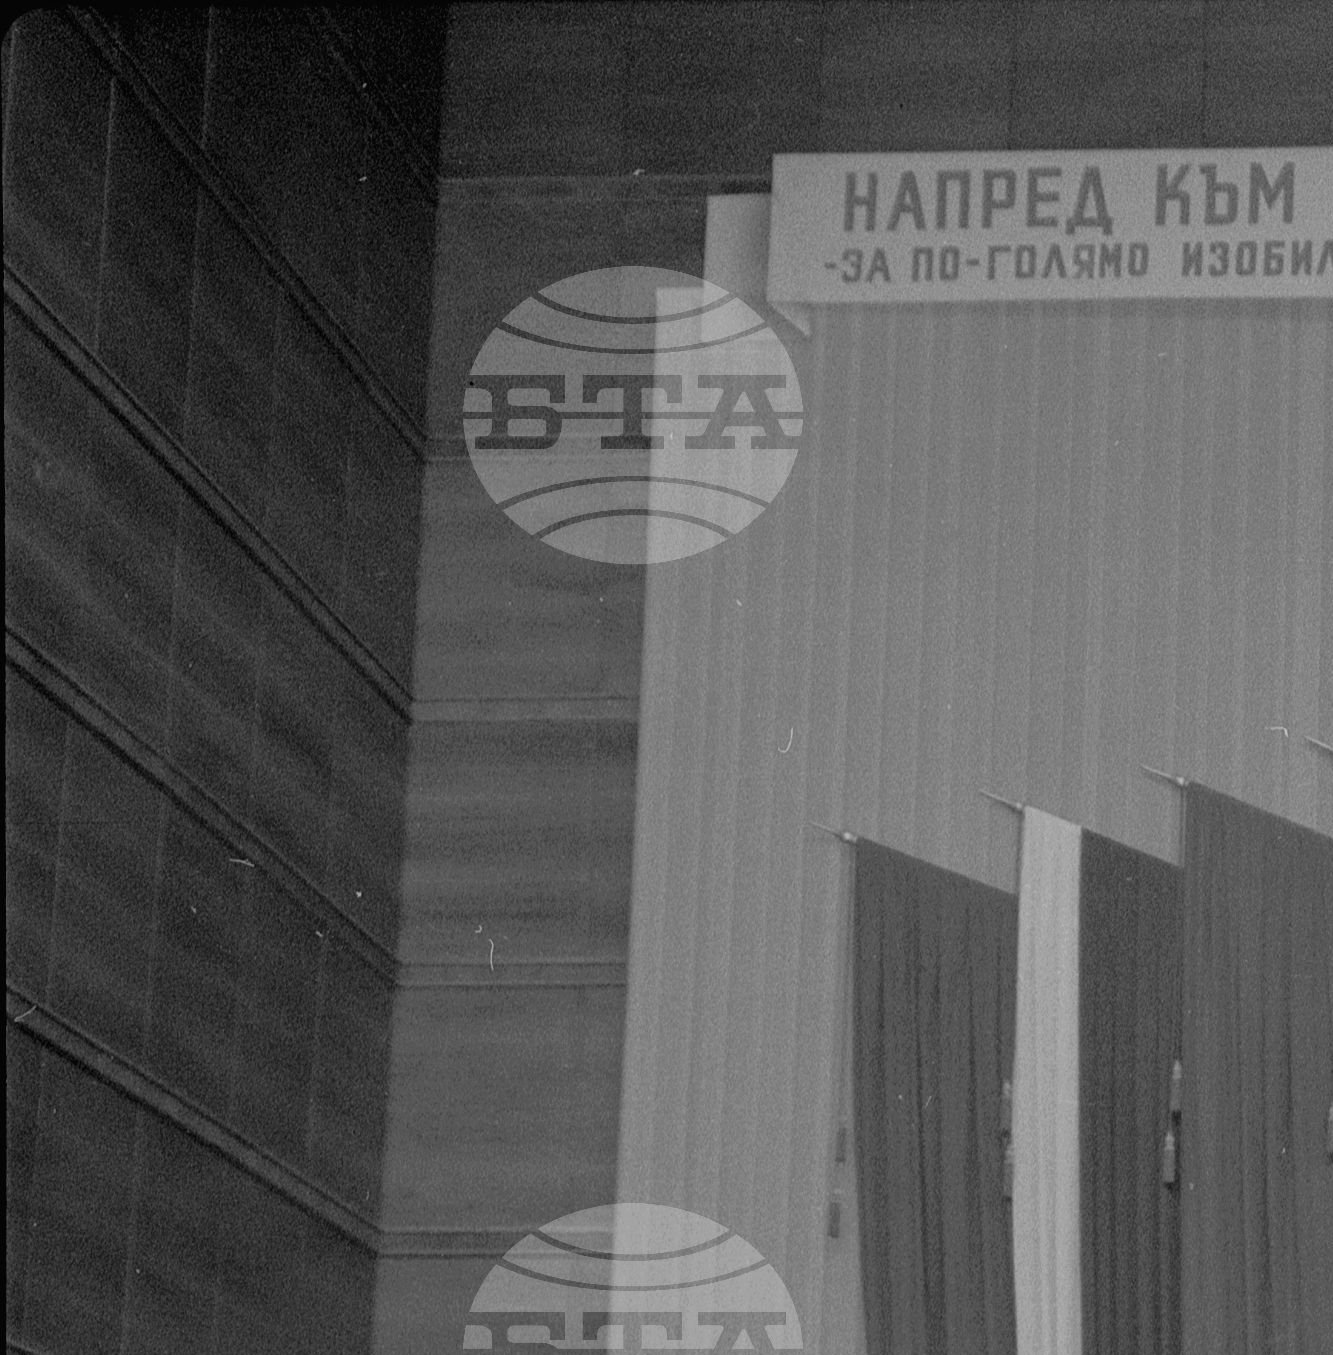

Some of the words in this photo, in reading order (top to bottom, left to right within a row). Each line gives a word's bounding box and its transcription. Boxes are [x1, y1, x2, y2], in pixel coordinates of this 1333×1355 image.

[844, 167, 1113, 236] НАПРЕД
[1155, 163, 1295, 227] КЪМ
[911, 242, 1149, 282] ПО-ГОЛЯМО
